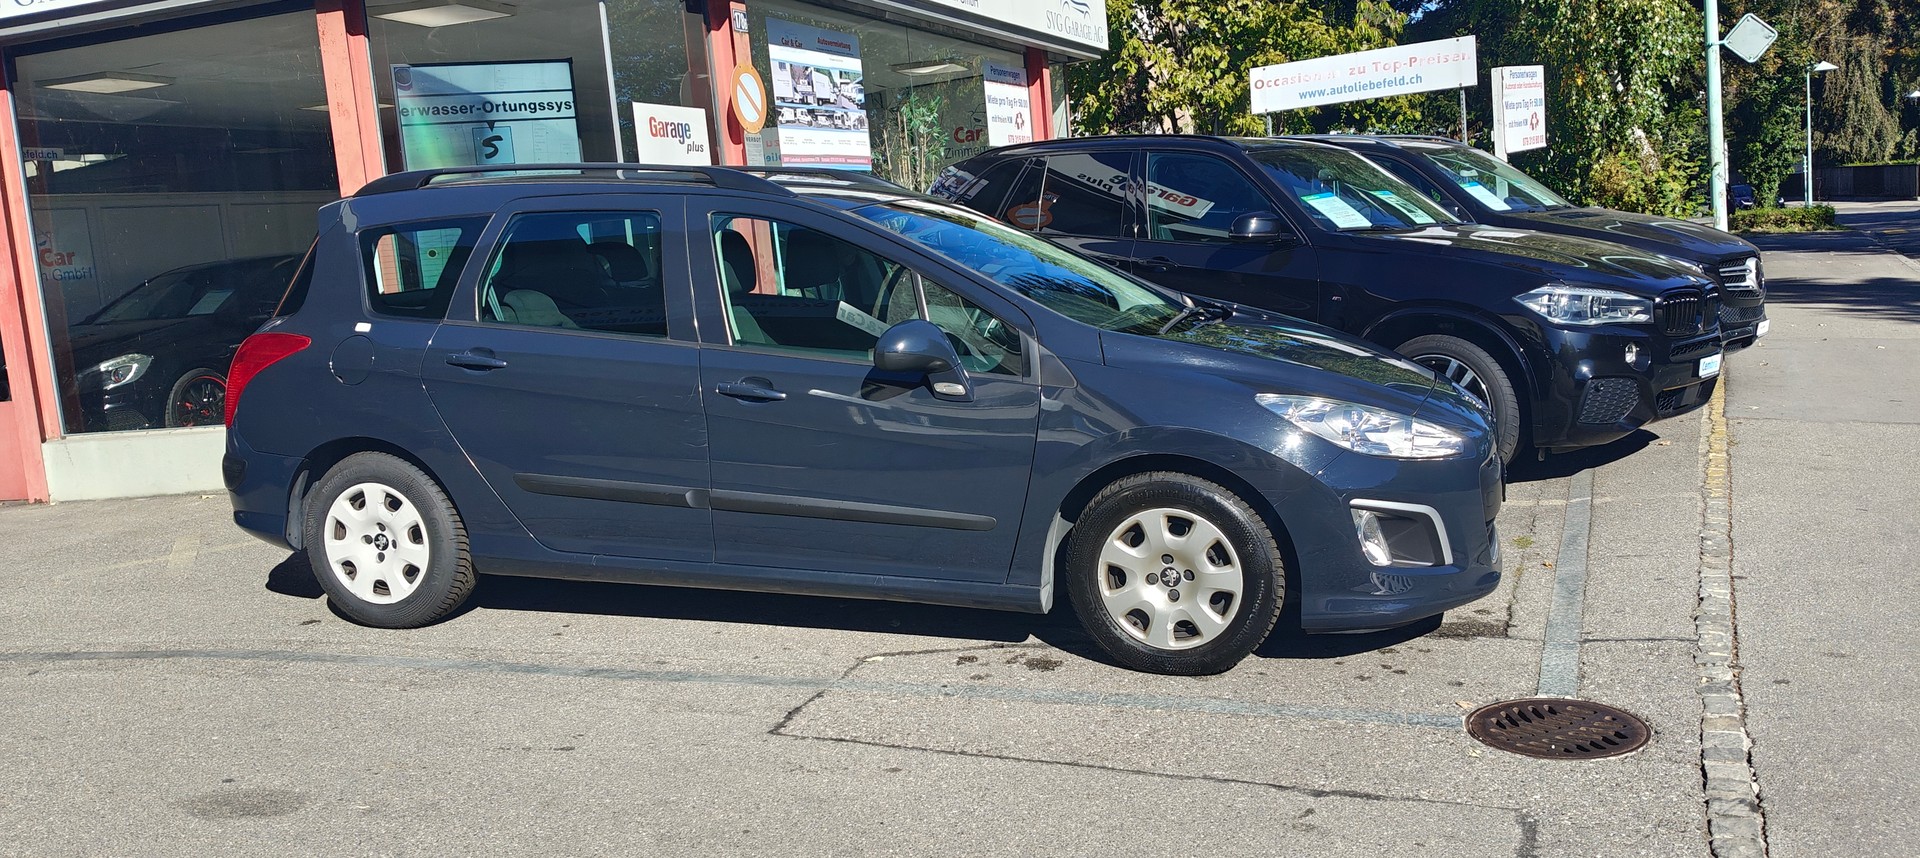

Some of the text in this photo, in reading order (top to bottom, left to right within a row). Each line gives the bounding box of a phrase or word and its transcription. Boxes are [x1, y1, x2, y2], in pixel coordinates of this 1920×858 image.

[1045, 9, 1063, 32] SVG
[1093, 25, 1104, 44] AG
[990, 65, 1020, 81] Personenwagen
[1348, 64, 1366, 76] zu
[1509, 70, 1537, 81] Personenwagen
[1298, 73, 1423, 100] www.autoliebefeld.ch
[987, 94, 998, 105] Miete
[1006, 96, 1014, 109] Tag
[648, 116, 692, 145] Garage
[953, 126, 982, 143] Car
[686, 141, 704, 154] plus
[40, 247, 76, 268] Car
[52, 266, 93, 282] GmbH
